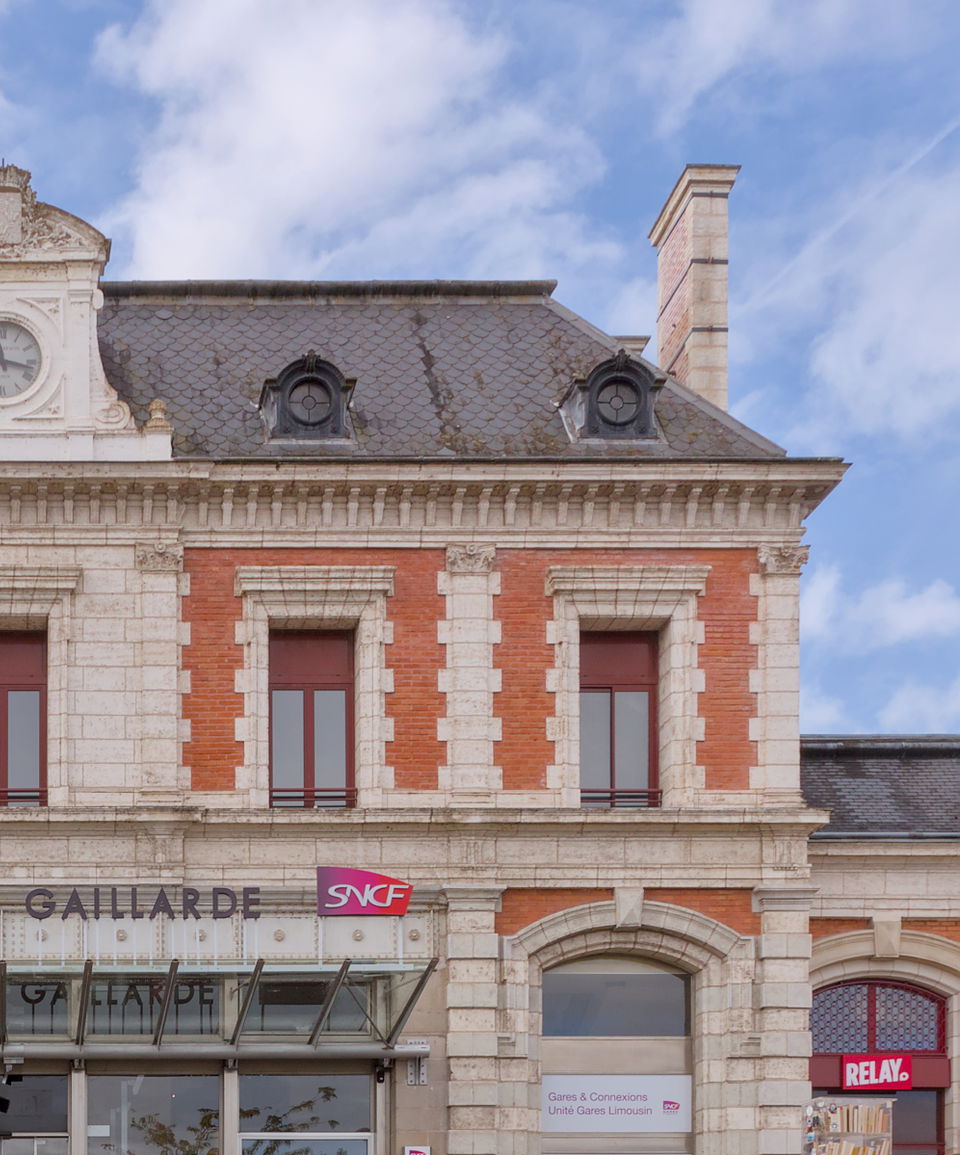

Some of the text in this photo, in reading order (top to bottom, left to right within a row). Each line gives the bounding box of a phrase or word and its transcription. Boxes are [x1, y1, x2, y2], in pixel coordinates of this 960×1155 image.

[25, 887, 260, 920] GAILLARDE
[324, 883, 410, 909] SNCF
[548, 1092, 648, 1102] Gares & Connexions
[548, 1105, 653, 1115] Unité Gares Limousin
